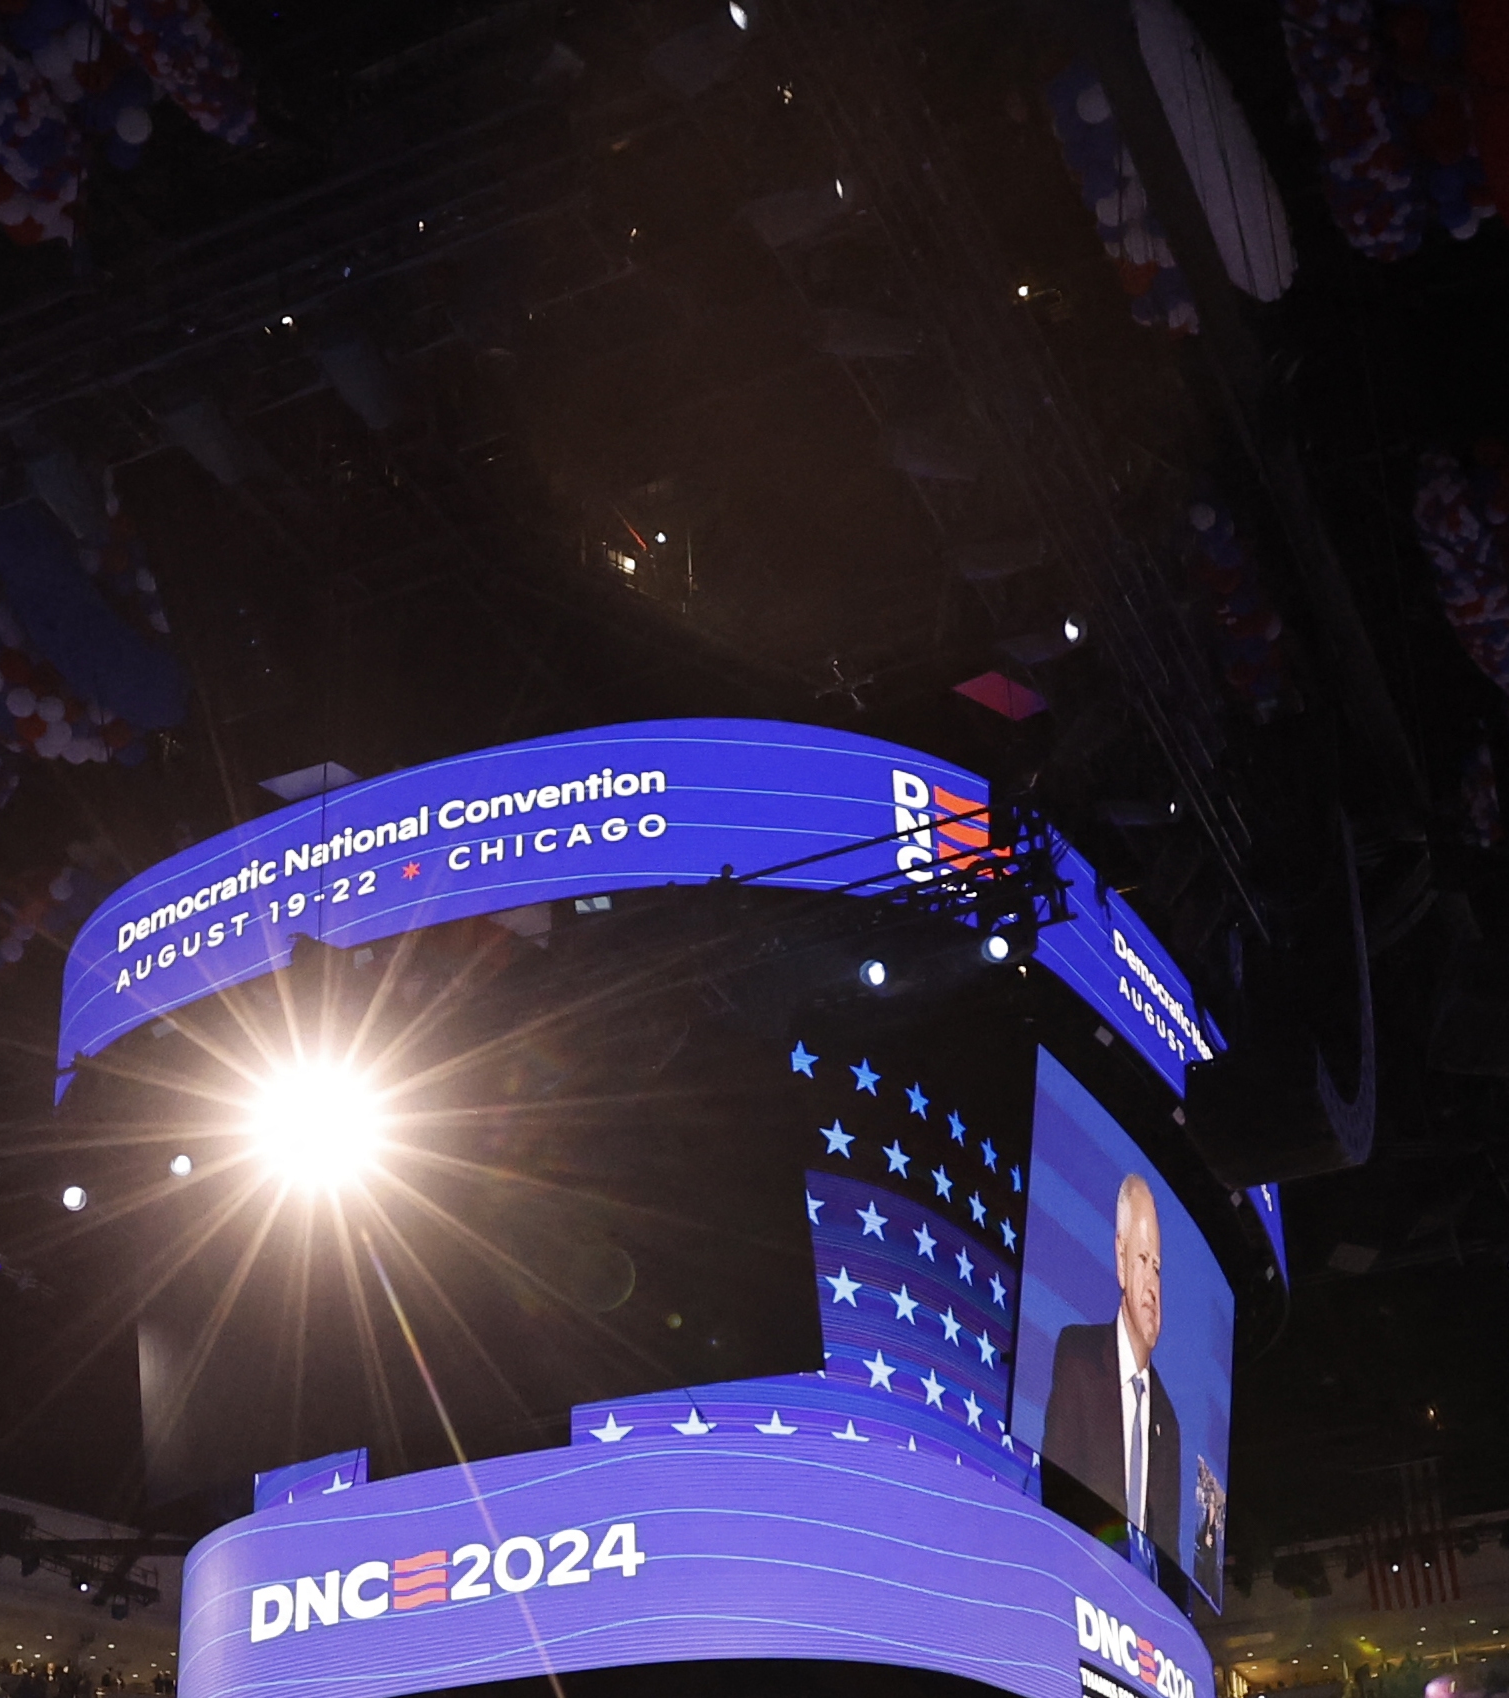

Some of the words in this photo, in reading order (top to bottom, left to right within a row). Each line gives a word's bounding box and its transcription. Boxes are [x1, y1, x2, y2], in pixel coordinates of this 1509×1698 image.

[115, 912, 248, 993] AUGUST
[270, 870, 377, 924] 19-22
[448, 814, 666, 870] CHICAGO
[117, 860, 276, 952] Democratic
[284, 806, 429, 877] National
[438, 768, 666, 829] Convention
[1112, 929, 1192, 1038] Democratic
[1118, 975, 1185, 1061] AUGUST
[251, 1561, 389, 1643] DNC
[450, 1522, 645, 1601] 2024
[1074, 1596, 1140, 1677] DNC
